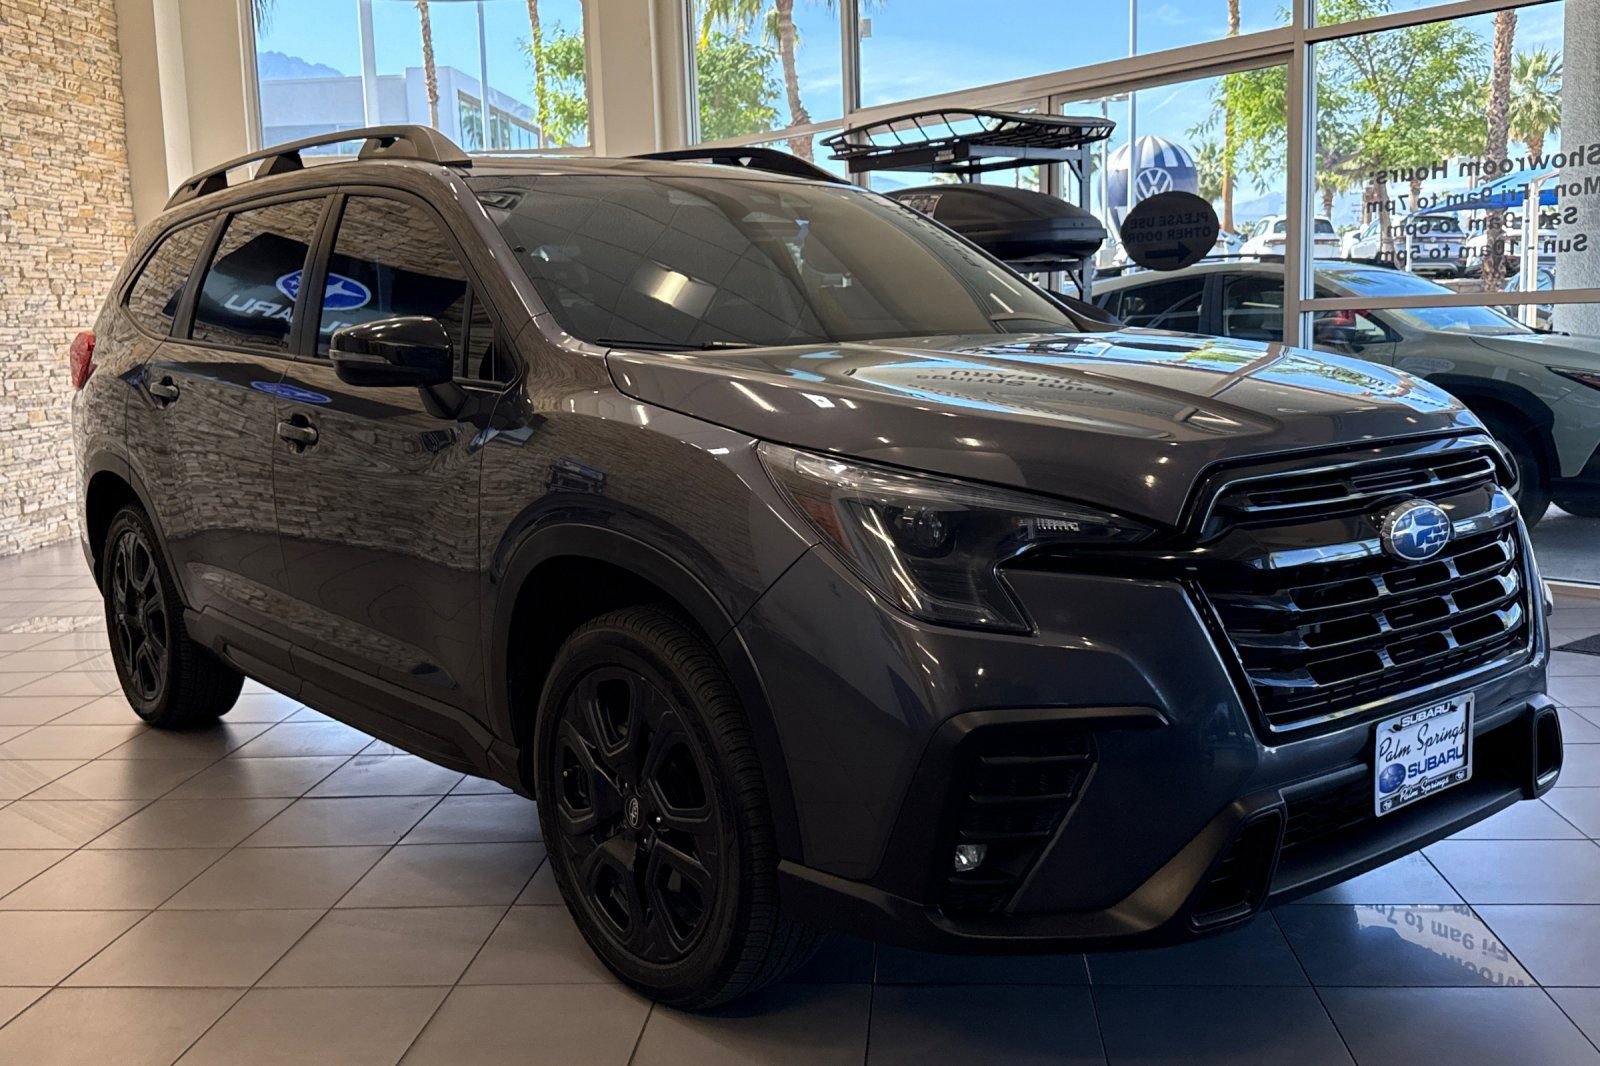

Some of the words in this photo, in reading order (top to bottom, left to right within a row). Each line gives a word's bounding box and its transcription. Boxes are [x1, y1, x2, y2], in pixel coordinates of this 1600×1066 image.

[1401, 703, 1451, 727] SUBARU
[1379, 737, 1411, 762] Palm
[1417, 722, 1466, 756] Springs
[1407, 744, 1465, 778] SUBARU
[1400, 784, 1418, 801] Palm
